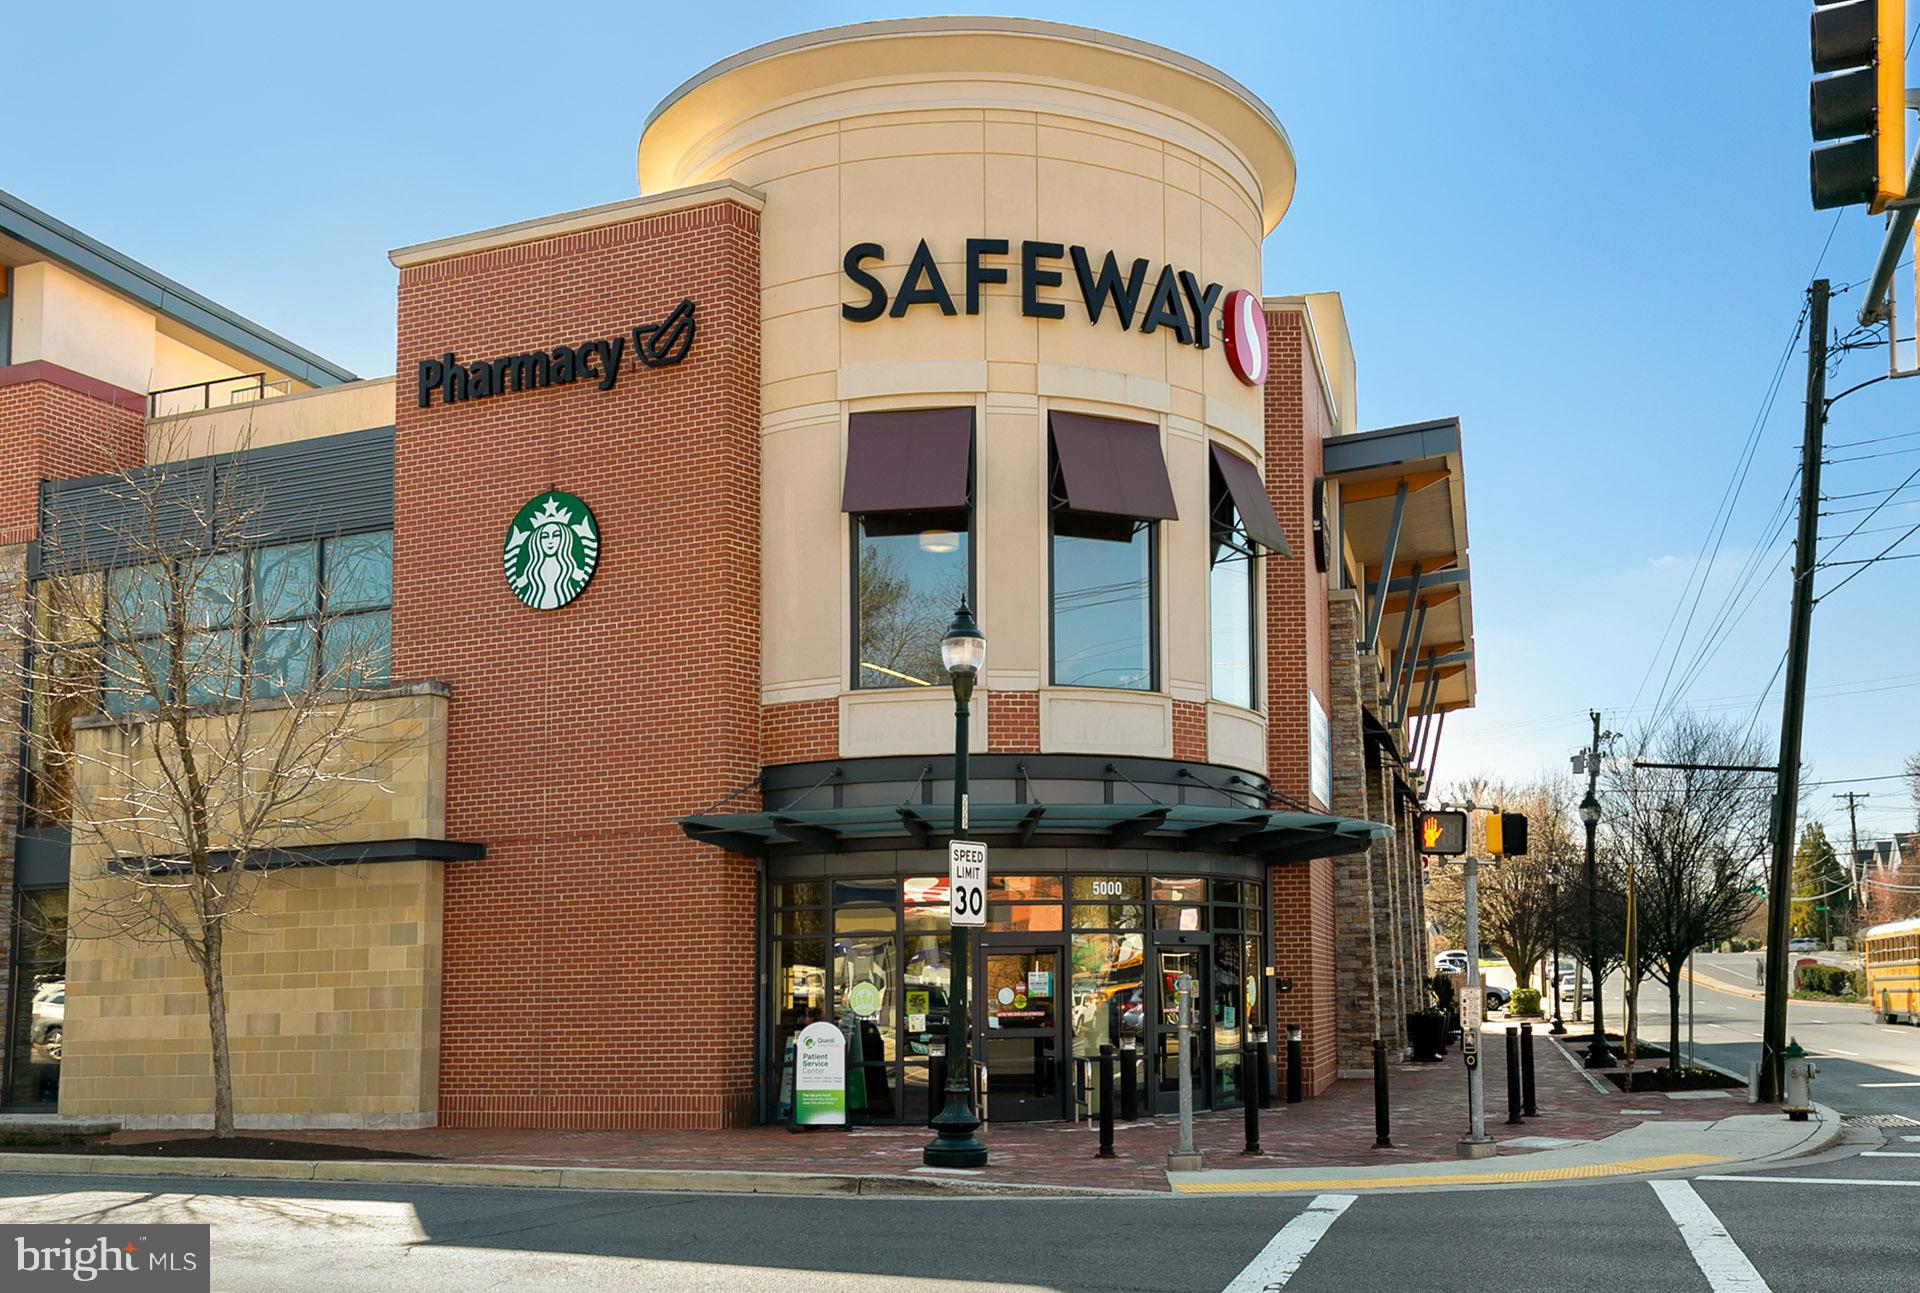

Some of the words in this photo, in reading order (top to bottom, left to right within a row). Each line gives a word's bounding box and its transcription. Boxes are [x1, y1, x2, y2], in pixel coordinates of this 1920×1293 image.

[842, 237, 1223, 350] SAFEWAY
[418, 337, 625, 408] Pharmacy
[953, 849, 984, 863] SPEED
[956, 866, 981, 880] LIMIT
[1092, 881, 1123, 895] 5000
[954, 885, 983, 916] 30
[802, 1060, 829, 1068] Service
